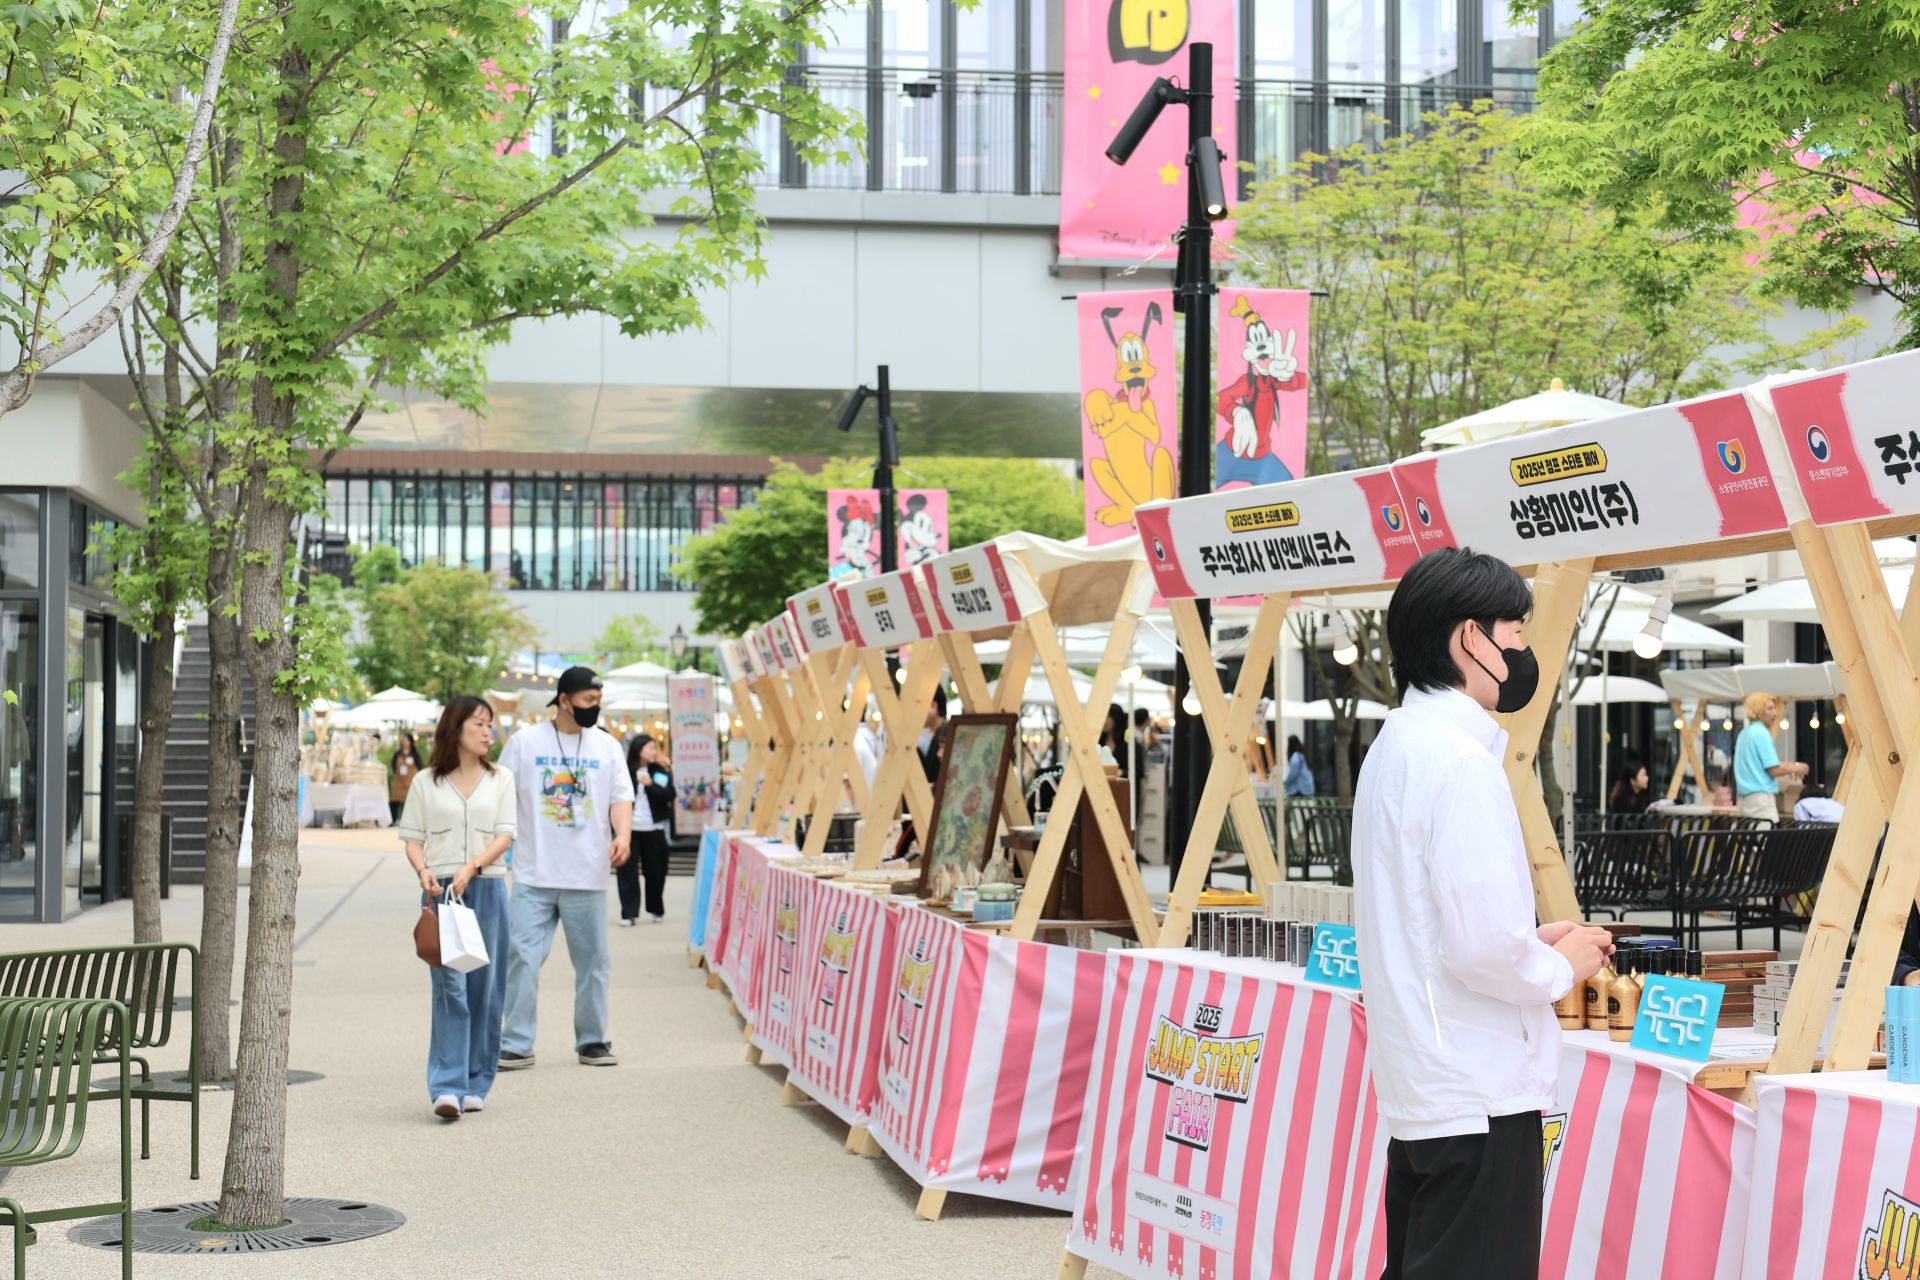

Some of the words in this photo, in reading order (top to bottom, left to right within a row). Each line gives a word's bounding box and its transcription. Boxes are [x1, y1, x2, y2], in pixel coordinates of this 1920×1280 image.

[1517, 463, 1546, 480] 2025년
[1547, 460, 1560, 475] 점프
[1561, 455, 1583, 472] 스타트
[1230, 514, 1253, 528] 2025년
[1265, 508, 1281, 523] 스타트
[1510, 480, 1639, 540] 상황미인(주)
[1200, 540, 1266, 578] 주식회사
[1263, 530, 1356, 572] 비앤씨코스
[1196, 1006, 1220, 1026] 2025
[1148, 1021, 1197, 1080] JUMP
[1193, 1038, 1261, 1095] START
[1168, 1086, 1213, 1143] FAIR
[1865, 1199, 1920, 1280] JU
